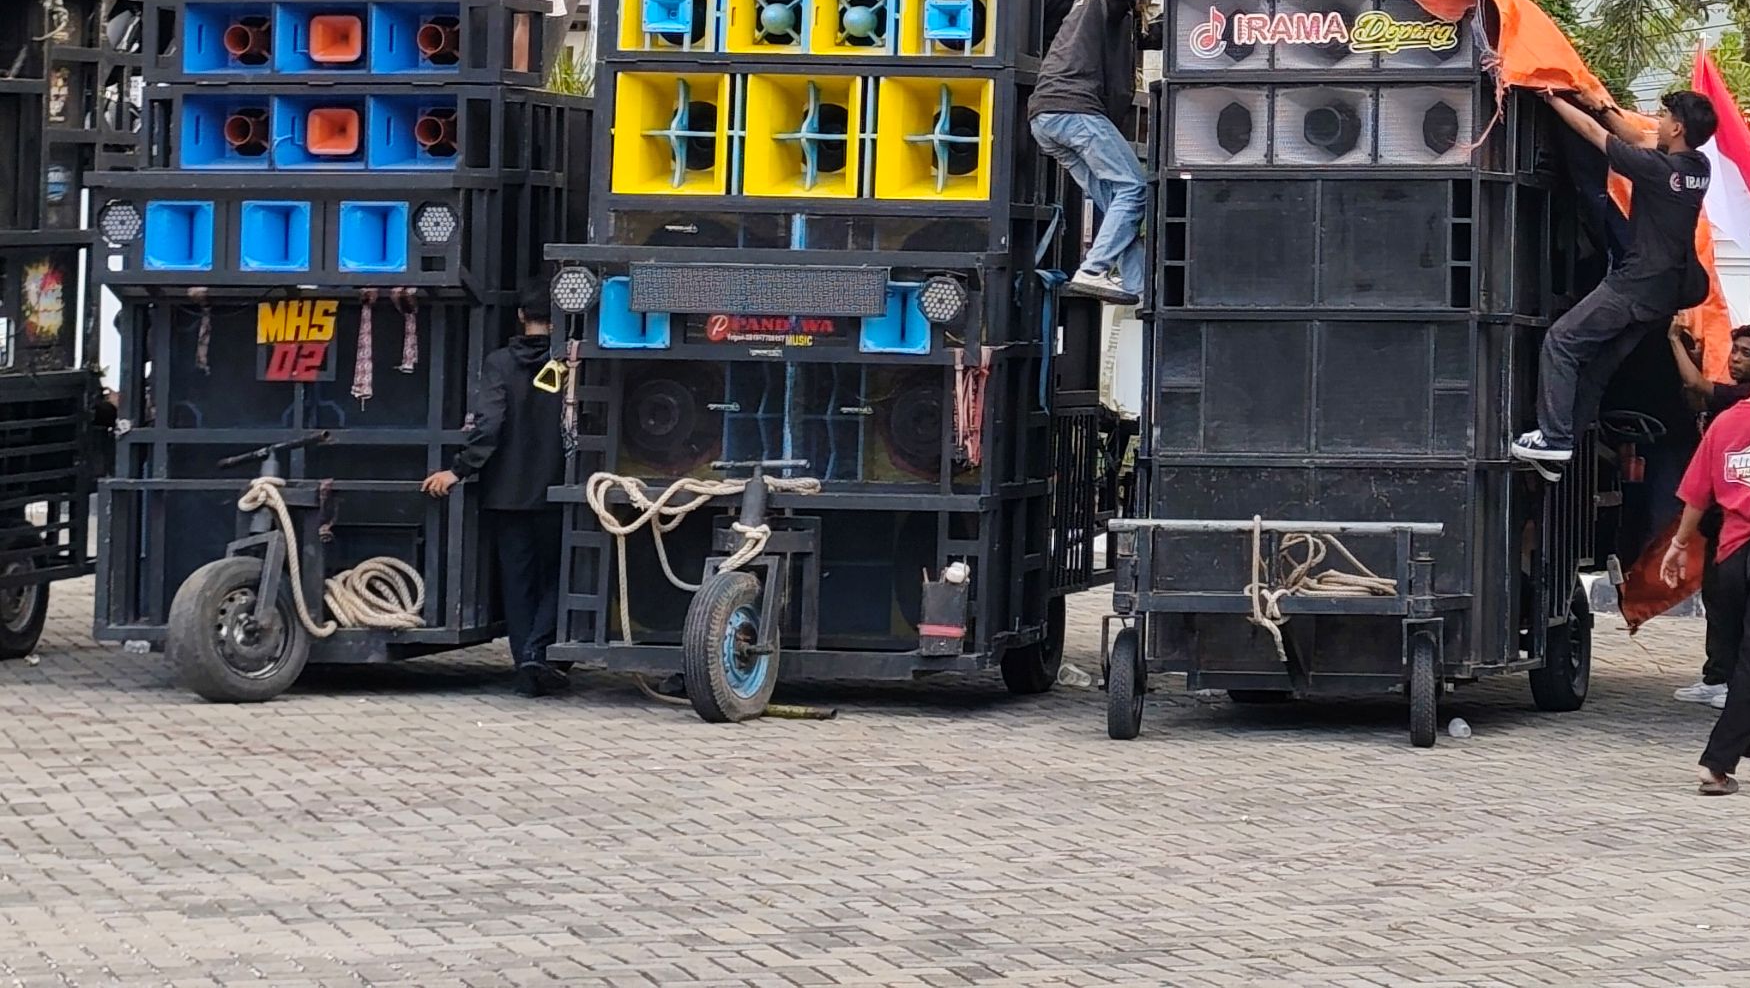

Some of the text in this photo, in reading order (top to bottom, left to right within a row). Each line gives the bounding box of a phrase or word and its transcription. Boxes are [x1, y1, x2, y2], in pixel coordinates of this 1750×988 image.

[1234, 11, 1349, 45] IRAMA
[1685, 175, 1709, 189] IRAM
[256, 299, 339, 344] MHS
[785, 334, 813, 347] MUSIC
[265, 342, 329, 381] 02
